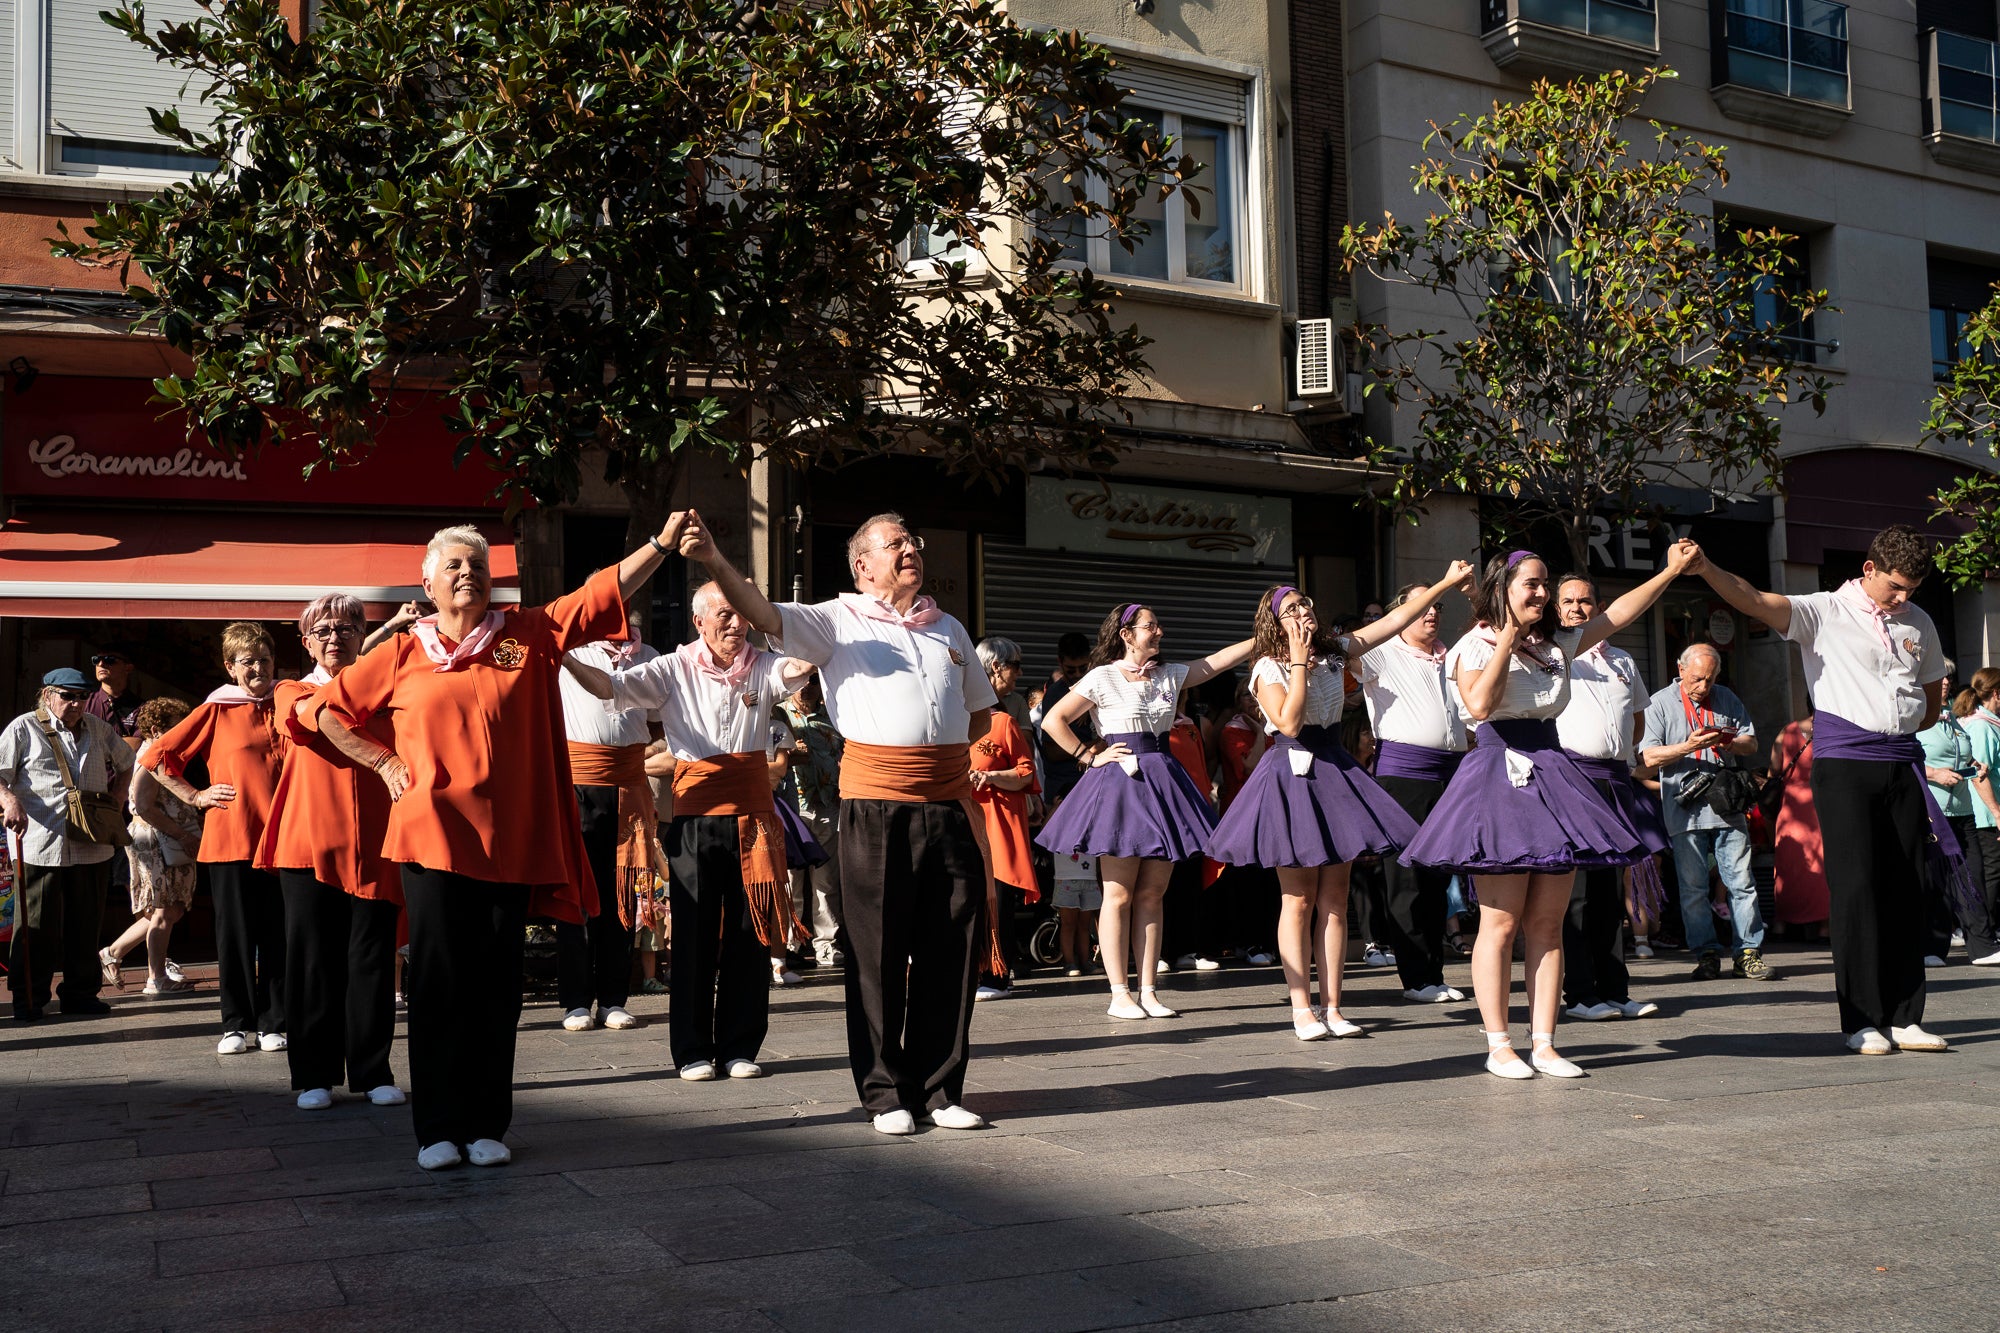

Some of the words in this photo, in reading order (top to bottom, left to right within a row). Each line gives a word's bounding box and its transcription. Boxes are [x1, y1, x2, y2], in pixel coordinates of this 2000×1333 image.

[28, 435, 248, 481] Caramelini
[1065, 492, 1239, 531] Cristina
[928, 576, 957, 594] 36
